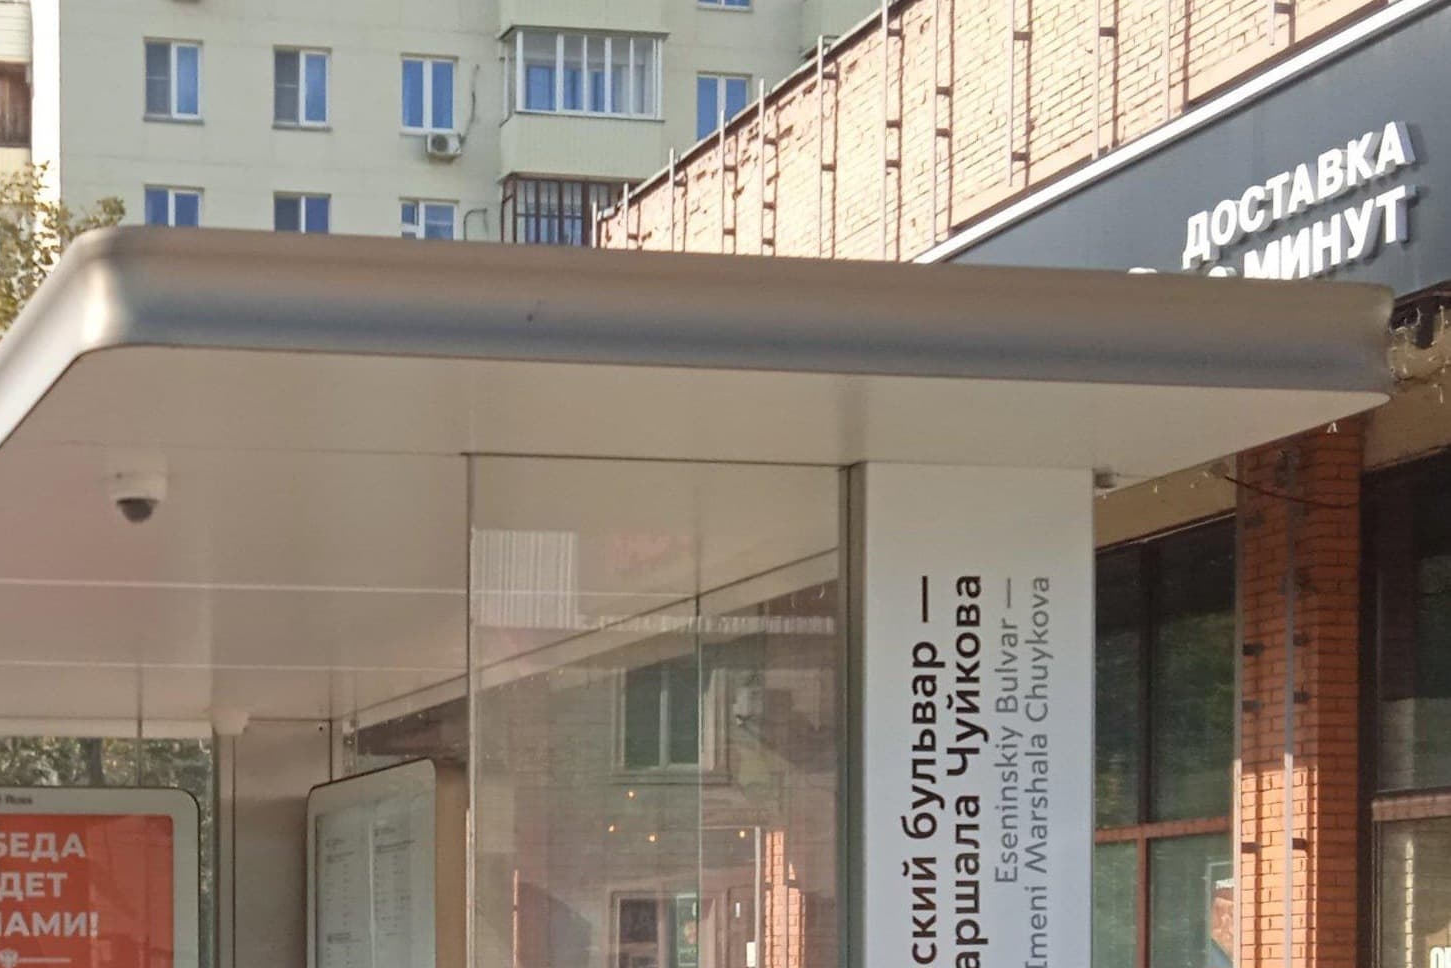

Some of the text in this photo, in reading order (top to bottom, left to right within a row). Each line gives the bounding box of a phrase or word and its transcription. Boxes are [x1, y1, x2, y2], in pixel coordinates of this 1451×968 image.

[1182, 121, 1413, 270] ДОСТАВКА
[1244, 185, 1413, 280] МИНУТ
[946, 575, 989, 777] Чуйкова
[994, 618, 1019, 712] Bulvar
[1025, 576, 1053, 723] Chuykova
[901, 640, 946, 840] бульвар
[994, 725, 1024, 883] Eseninskiy
[1024, 733, 1049, 874] Marshala
